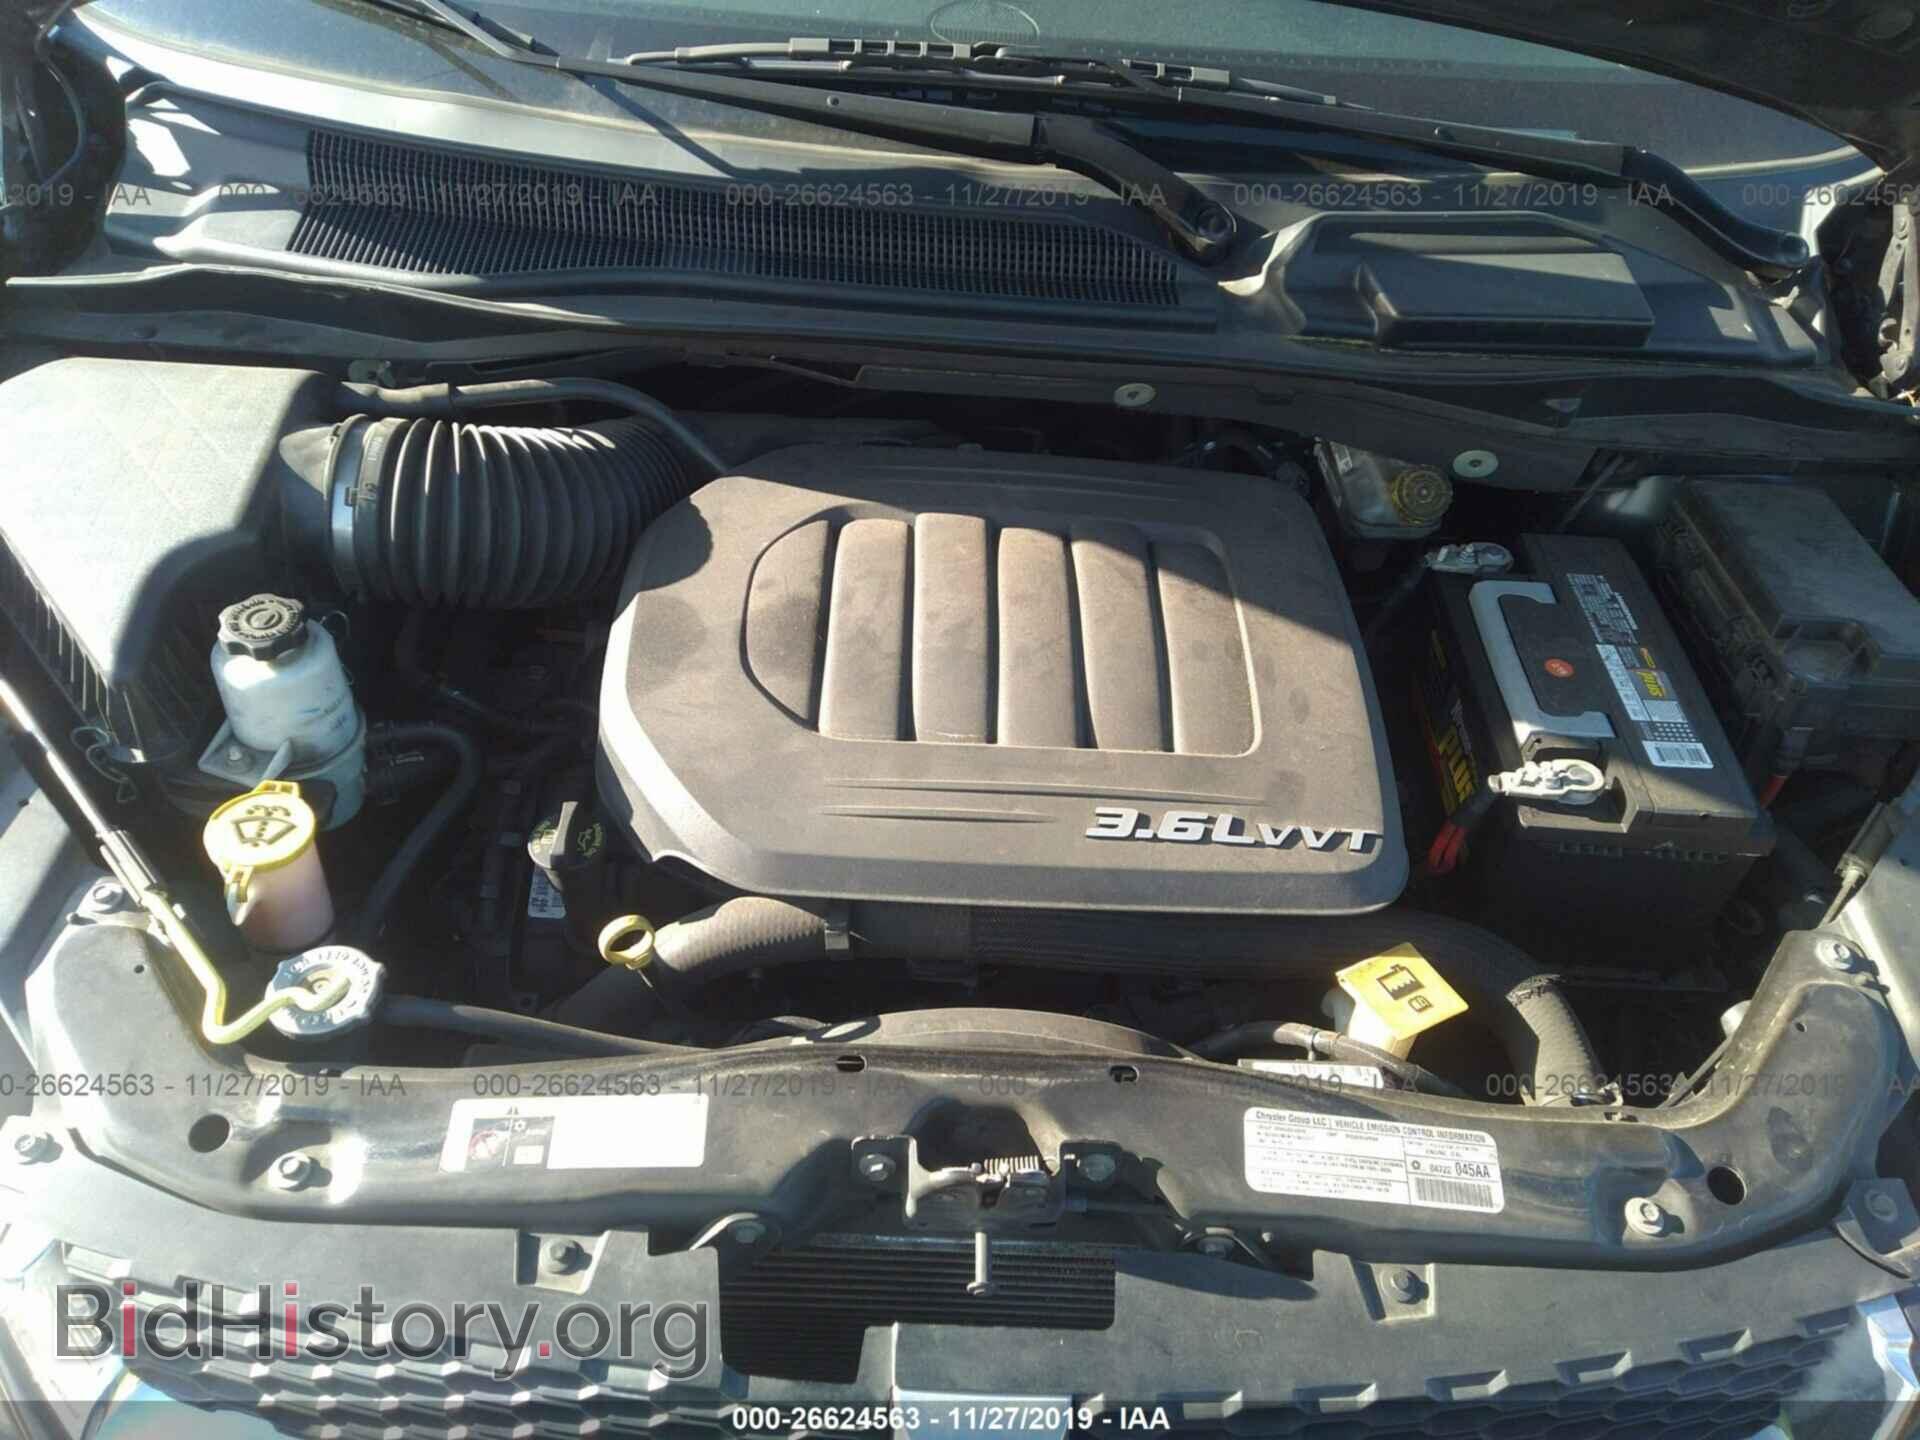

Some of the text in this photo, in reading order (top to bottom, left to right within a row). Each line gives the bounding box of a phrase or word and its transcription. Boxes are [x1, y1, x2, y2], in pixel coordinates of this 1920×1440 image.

[1256, 1110, 1286, 1122] Chrysler
[1288, 1114, 1311, 1126] Group
[1335, 1120, 1364, 1131] VEHICLE
[1366, 1122, 1401, 1134] EMISSION
[1402, 1126, 1434, 1138] CONTROL
[1436, 1129, 1487, 1143] INFORMATION
